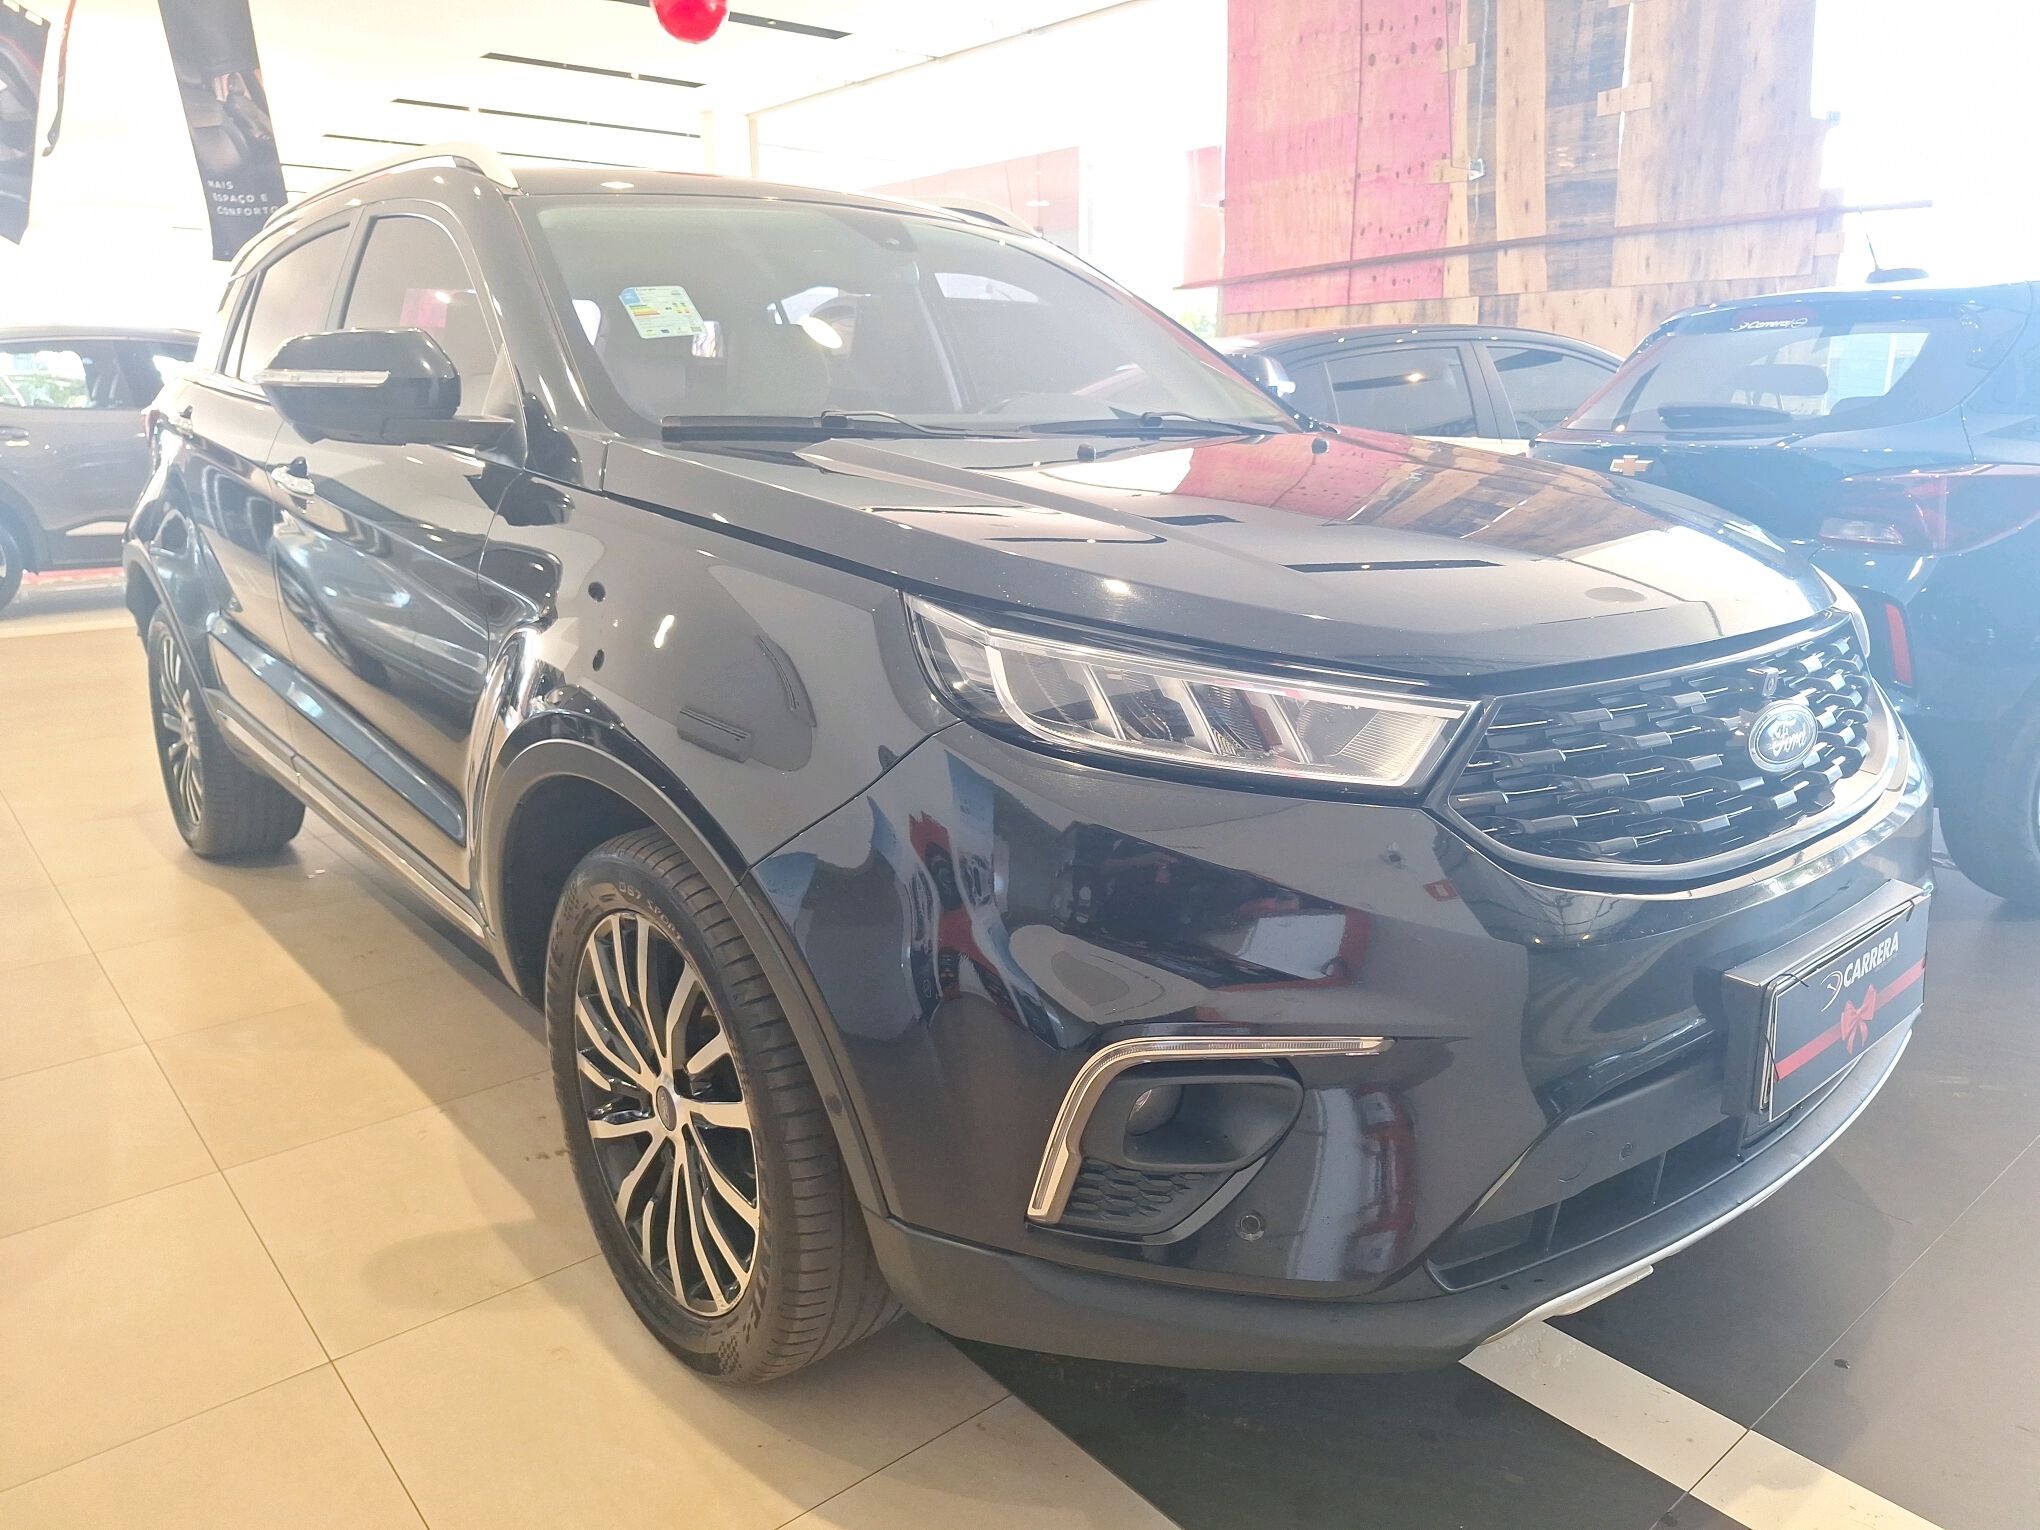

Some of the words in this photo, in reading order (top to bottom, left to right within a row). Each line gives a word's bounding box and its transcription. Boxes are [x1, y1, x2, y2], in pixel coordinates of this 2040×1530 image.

[206, 180, 234, 190] MAIS
[212, 192, 255, 204] ESPAÇO
[260, 193, 268, 202] E
[1767, 720, 1806, 758] Ford
[1843, 931, 1899, 988] CARRERA
